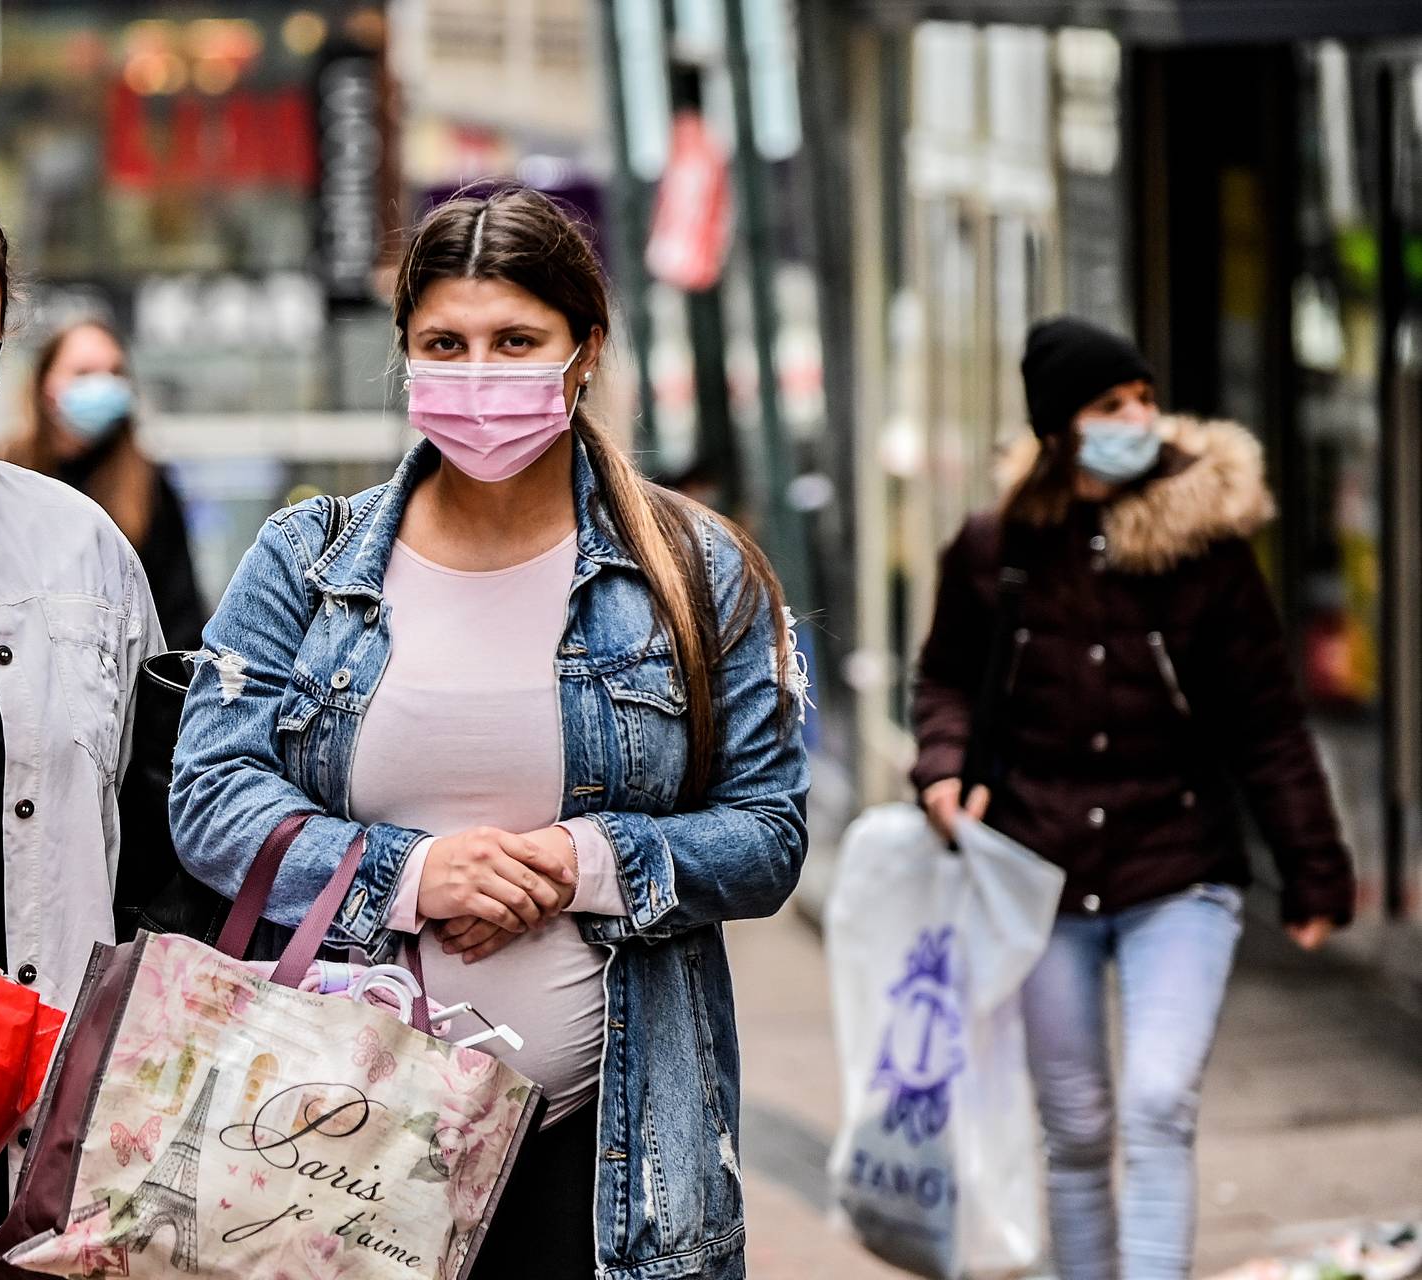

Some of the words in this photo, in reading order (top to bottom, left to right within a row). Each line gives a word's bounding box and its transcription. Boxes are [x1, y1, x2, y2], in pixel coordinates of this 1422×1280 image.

[219, 1082, 388, 1201] Paris
[222, 1193, 314, 1243] je
[335, 1211, 421, 1268] t'aime
